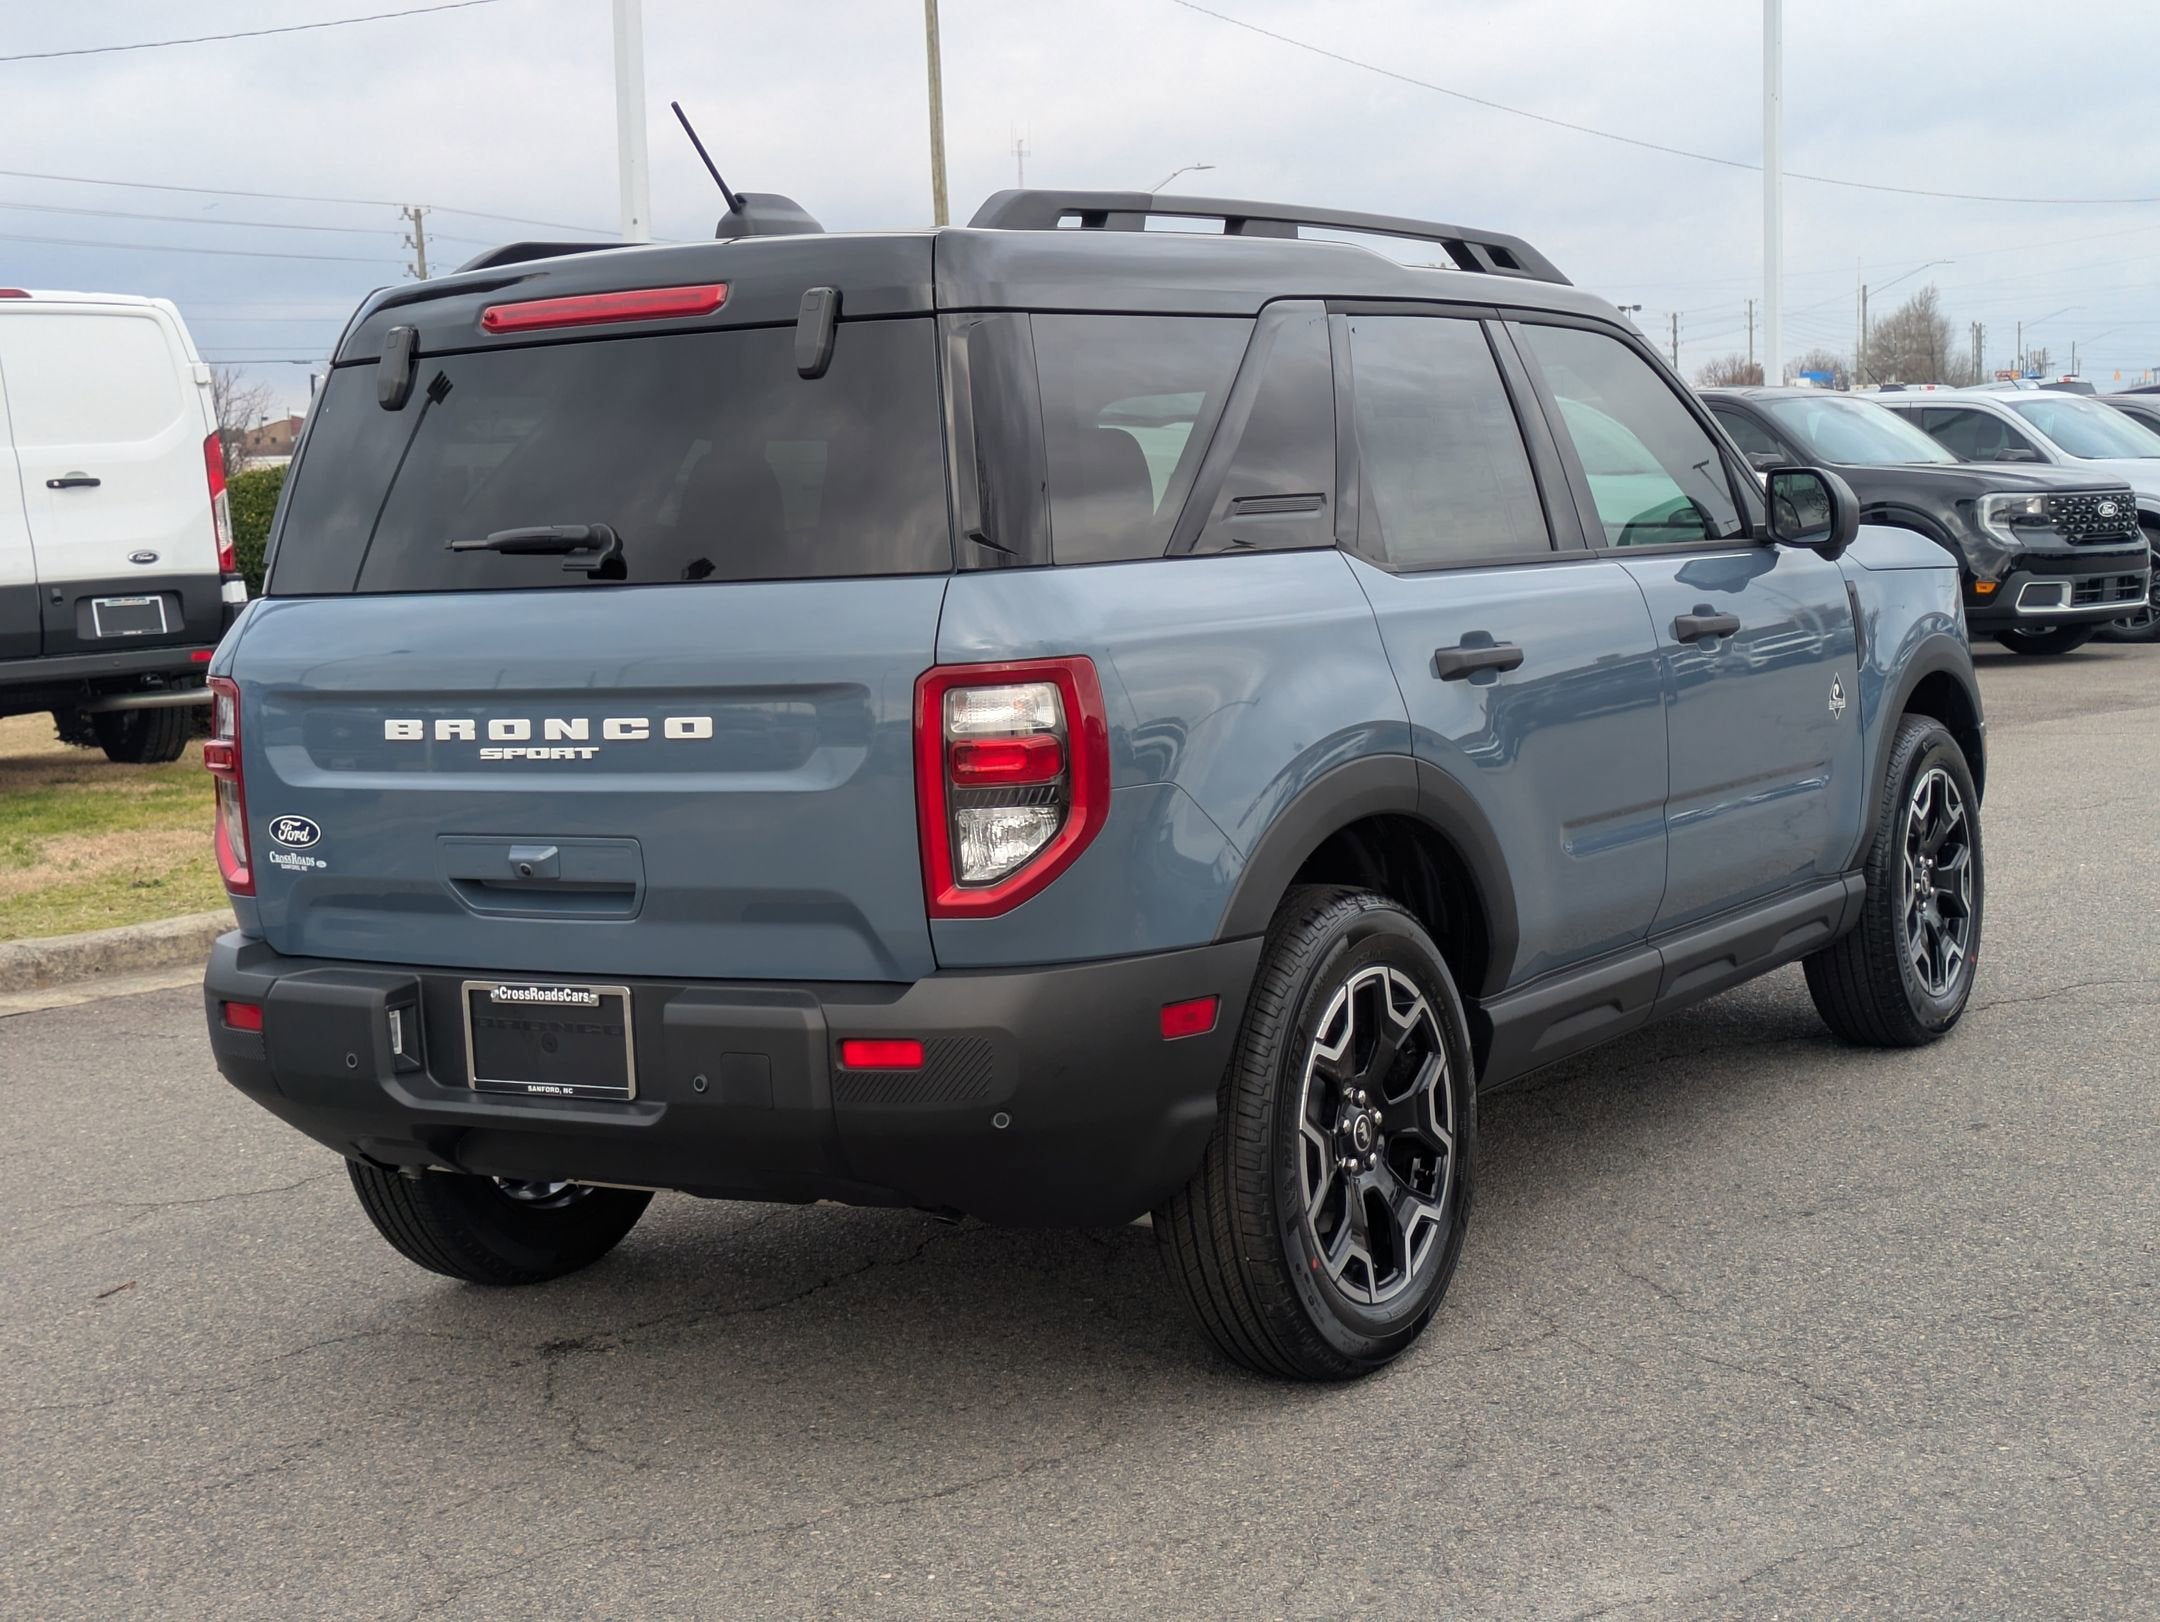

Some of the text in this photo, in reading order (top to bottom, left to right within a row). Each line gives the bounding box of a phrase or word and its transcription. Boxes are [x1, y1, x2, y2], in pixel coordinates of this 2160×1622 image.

[384, 717, 713, 740] BRONCO
[479, 747, 600, 760] SPORT
[278, 820, 310, 841] Ford
[499, 985, 589, 1003] CrossRoadsCars
